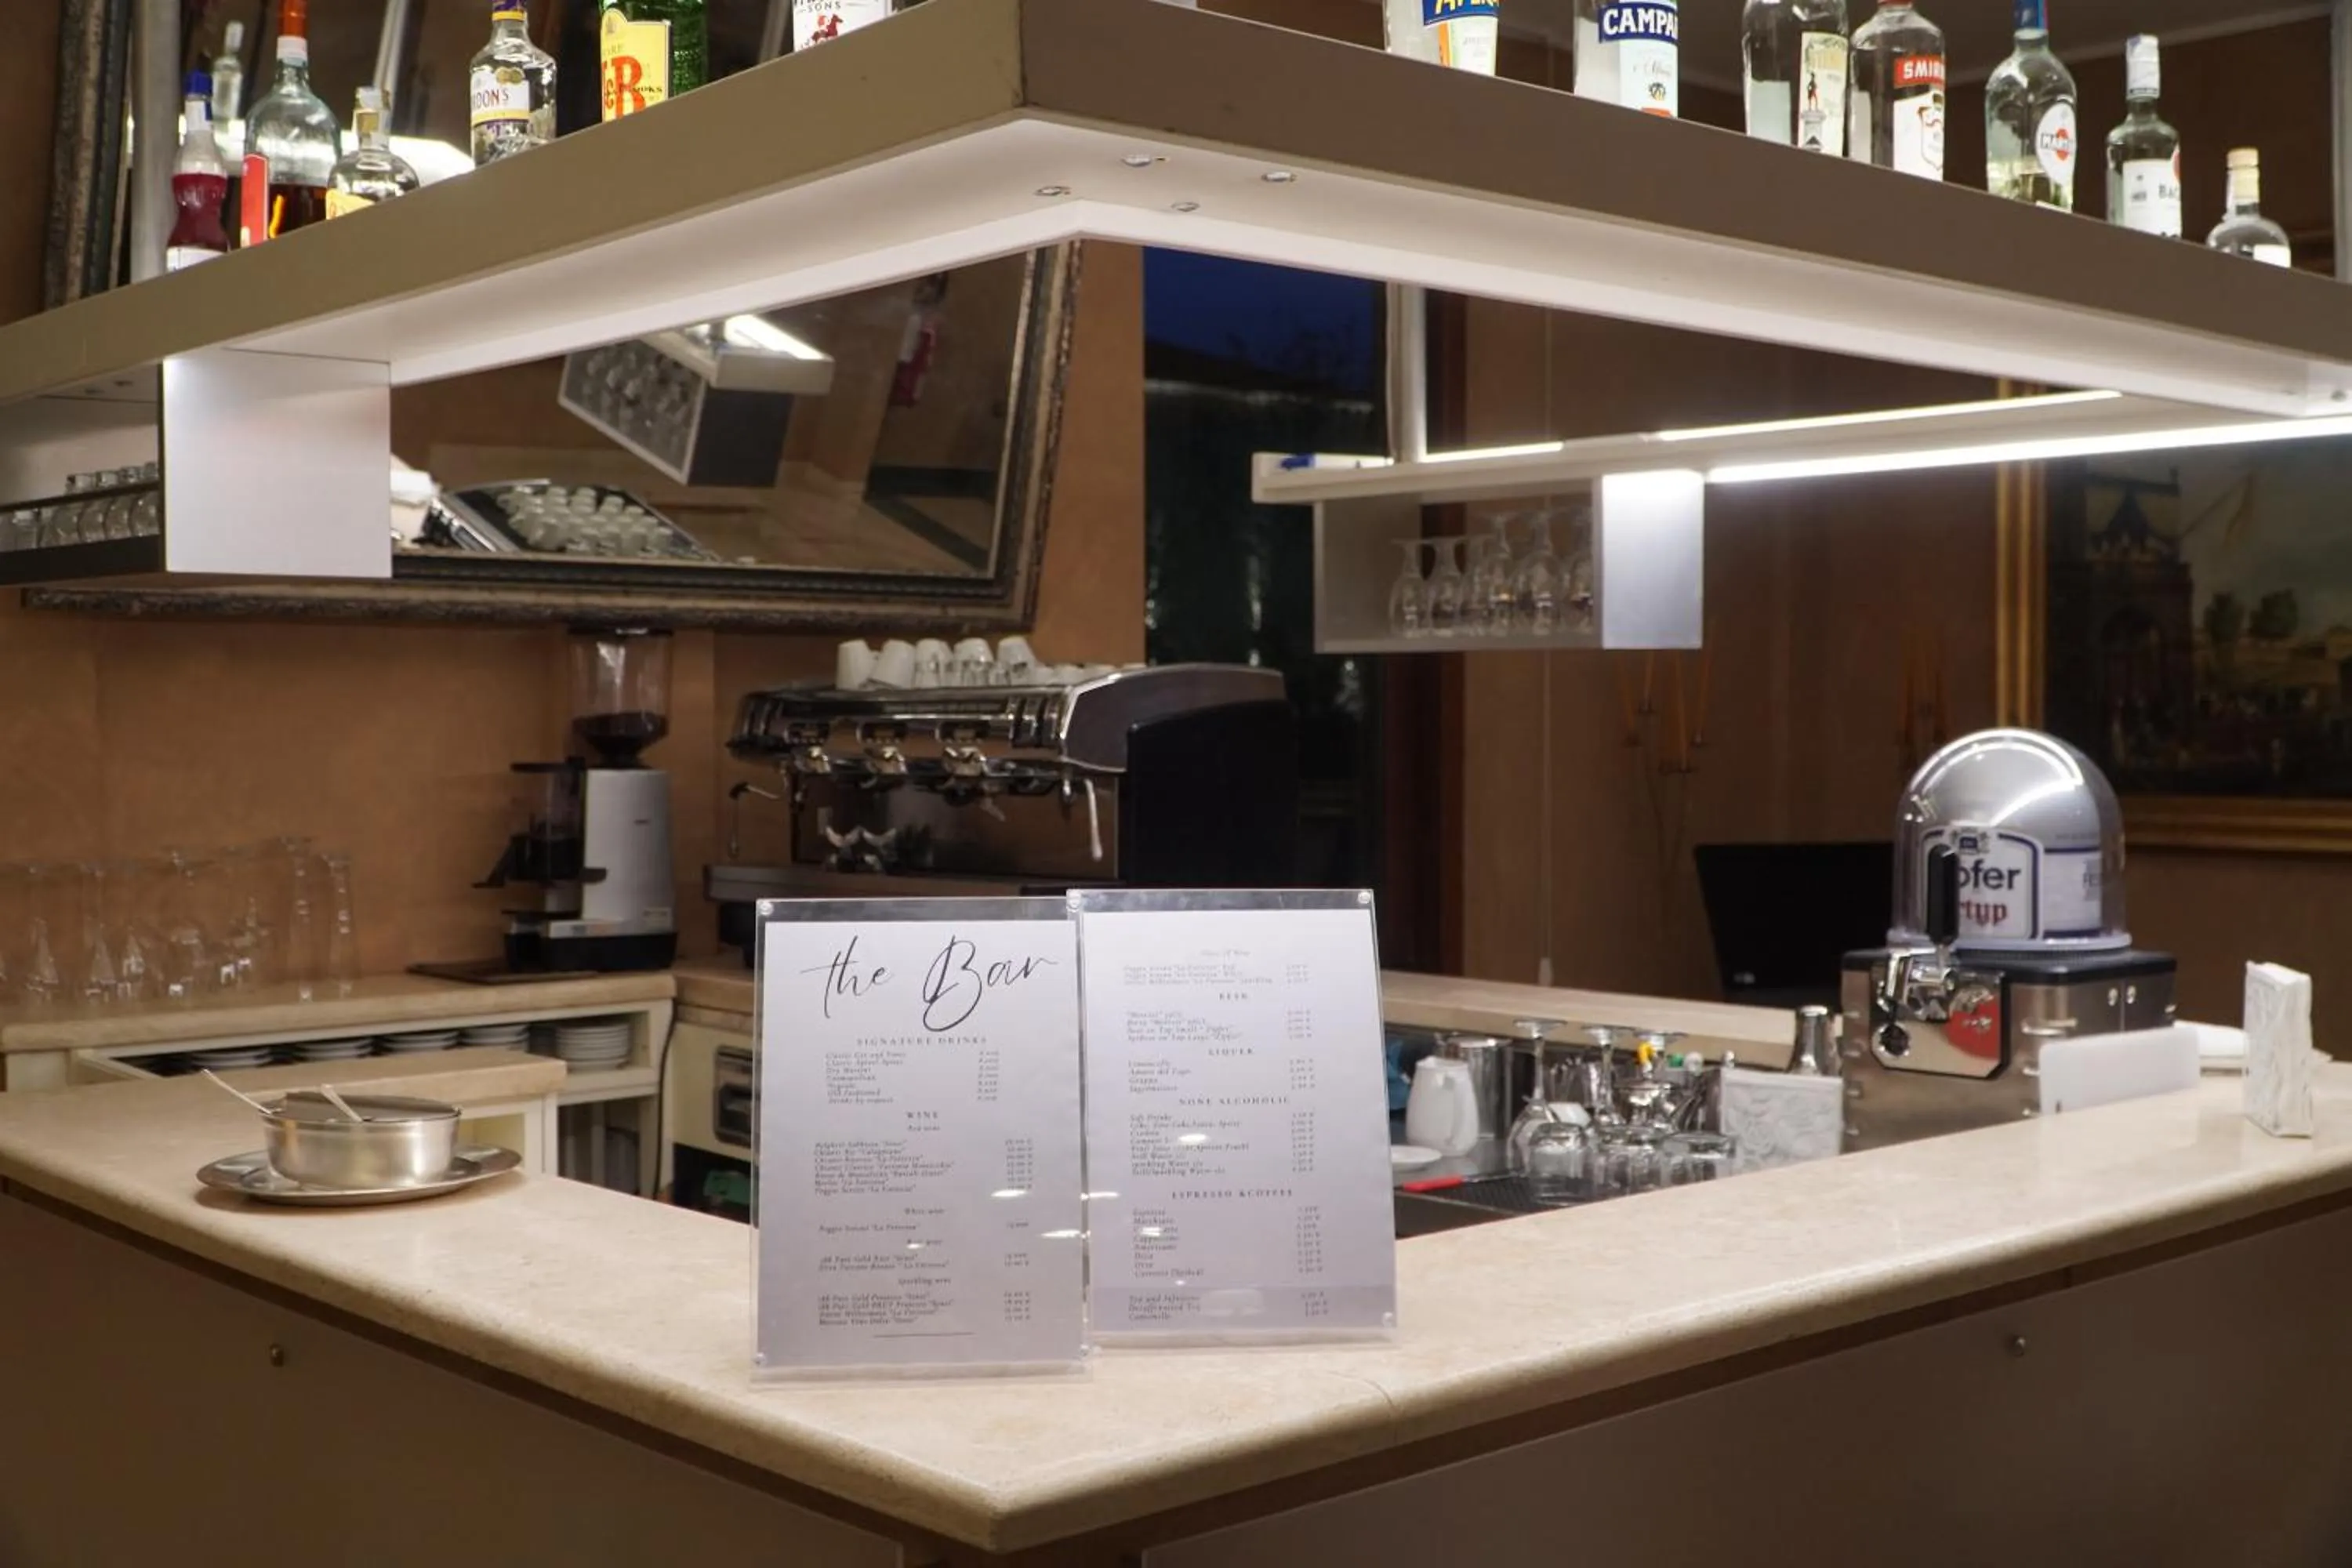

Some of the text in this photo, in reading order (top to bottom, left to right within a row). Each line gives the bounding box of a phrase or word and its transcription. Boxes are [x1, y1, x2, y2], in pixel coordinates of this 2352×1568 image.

[1603, 7, 1678, 39] CAMPA
[800, 935, 1059, 1032] the Bar
[856, 1036, 987, 1047] SIGNATURE DRINKS
